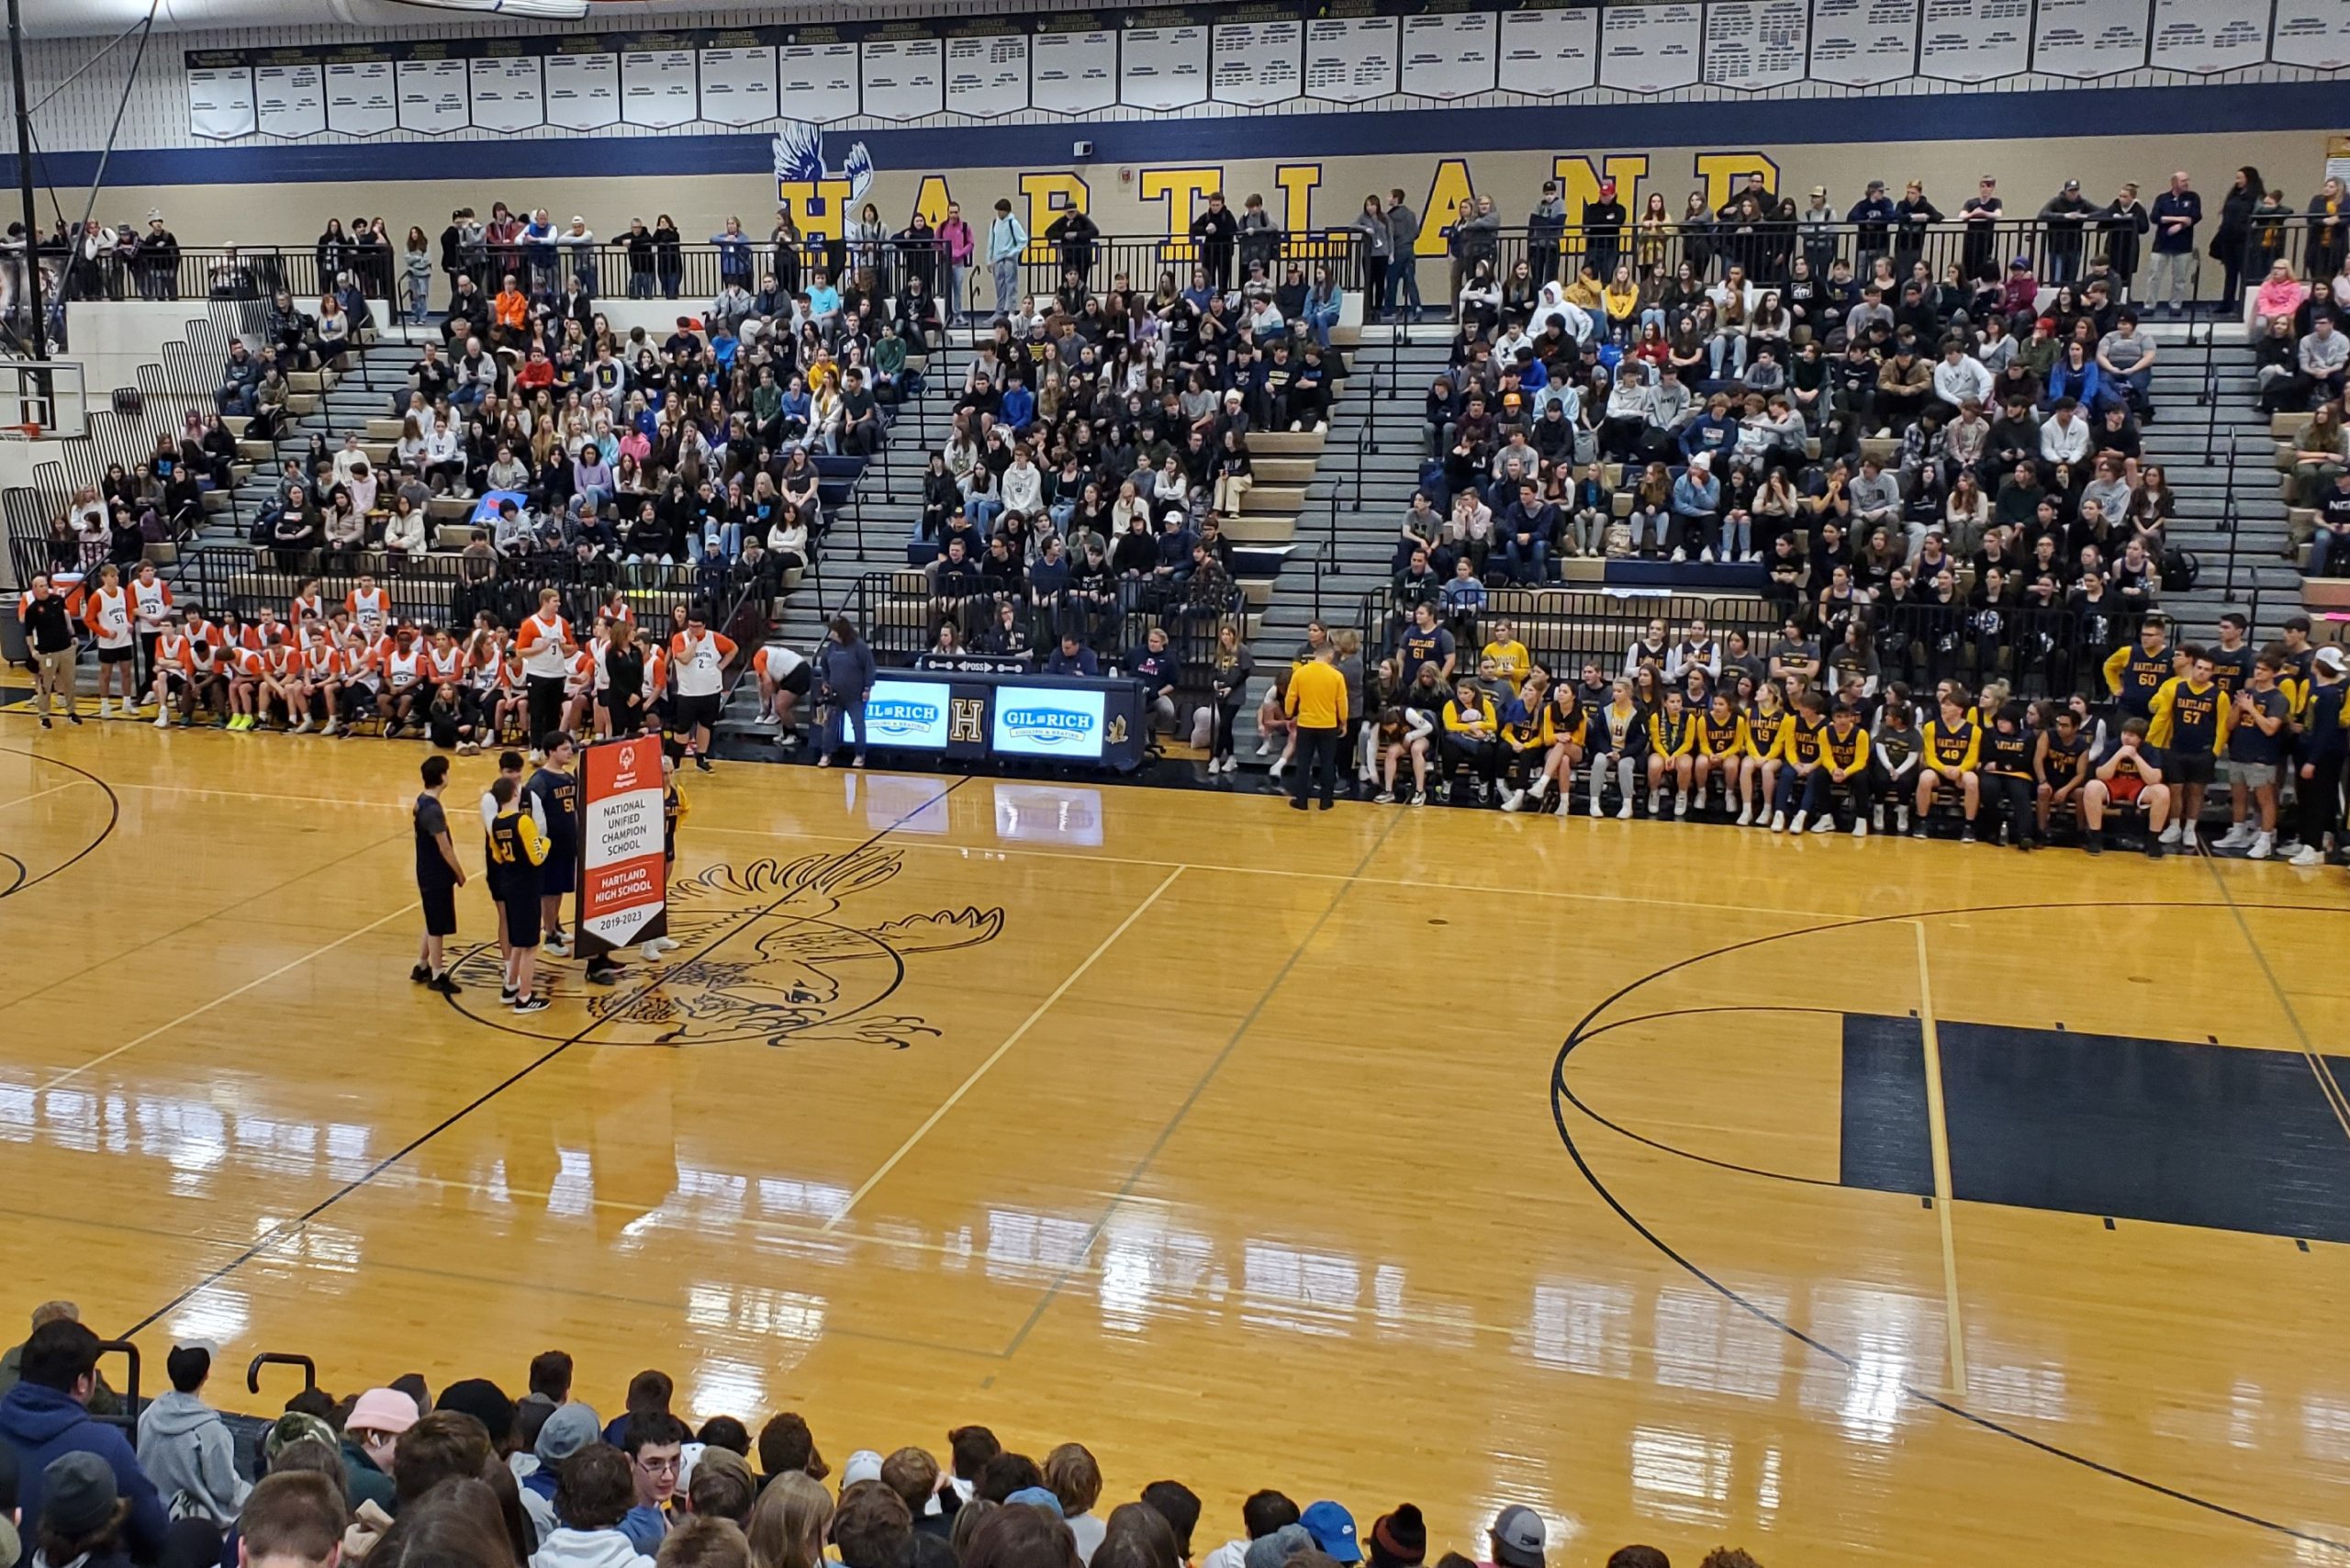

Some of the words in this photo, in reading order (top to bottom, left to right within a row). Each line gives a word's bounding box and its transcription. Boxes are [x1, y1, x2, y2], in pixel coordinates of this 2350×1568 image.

[146, 604, 157, 614] 33
[114, 614, 125, 624] 51
[551, 644, 557, 655] 3
[699, 658, 705, 669] 2
[966, 661, 984, 672] POSS
[2138, 673, 2157, 687] 60
[894, 705, 935, 720] RICH
[2182, 710, 2202, 724] 57
[949, 698, 984, 743] H
[1716, 741, 1725, 750] 6
[603, 799, 646, 817] NATIONAL
[608, 812, 640, 829] UNIFIED
[601, 824, 647, 844] CHAMPION
[608, 839, 641, 857] SCHOOL
[601, 868, 646, 889] HARTLAND
[595, 886, 617, 903] HIGH
[617, 879, 653, 899] SCHOOL
[599, 910, 643, 931] 2019-2023
